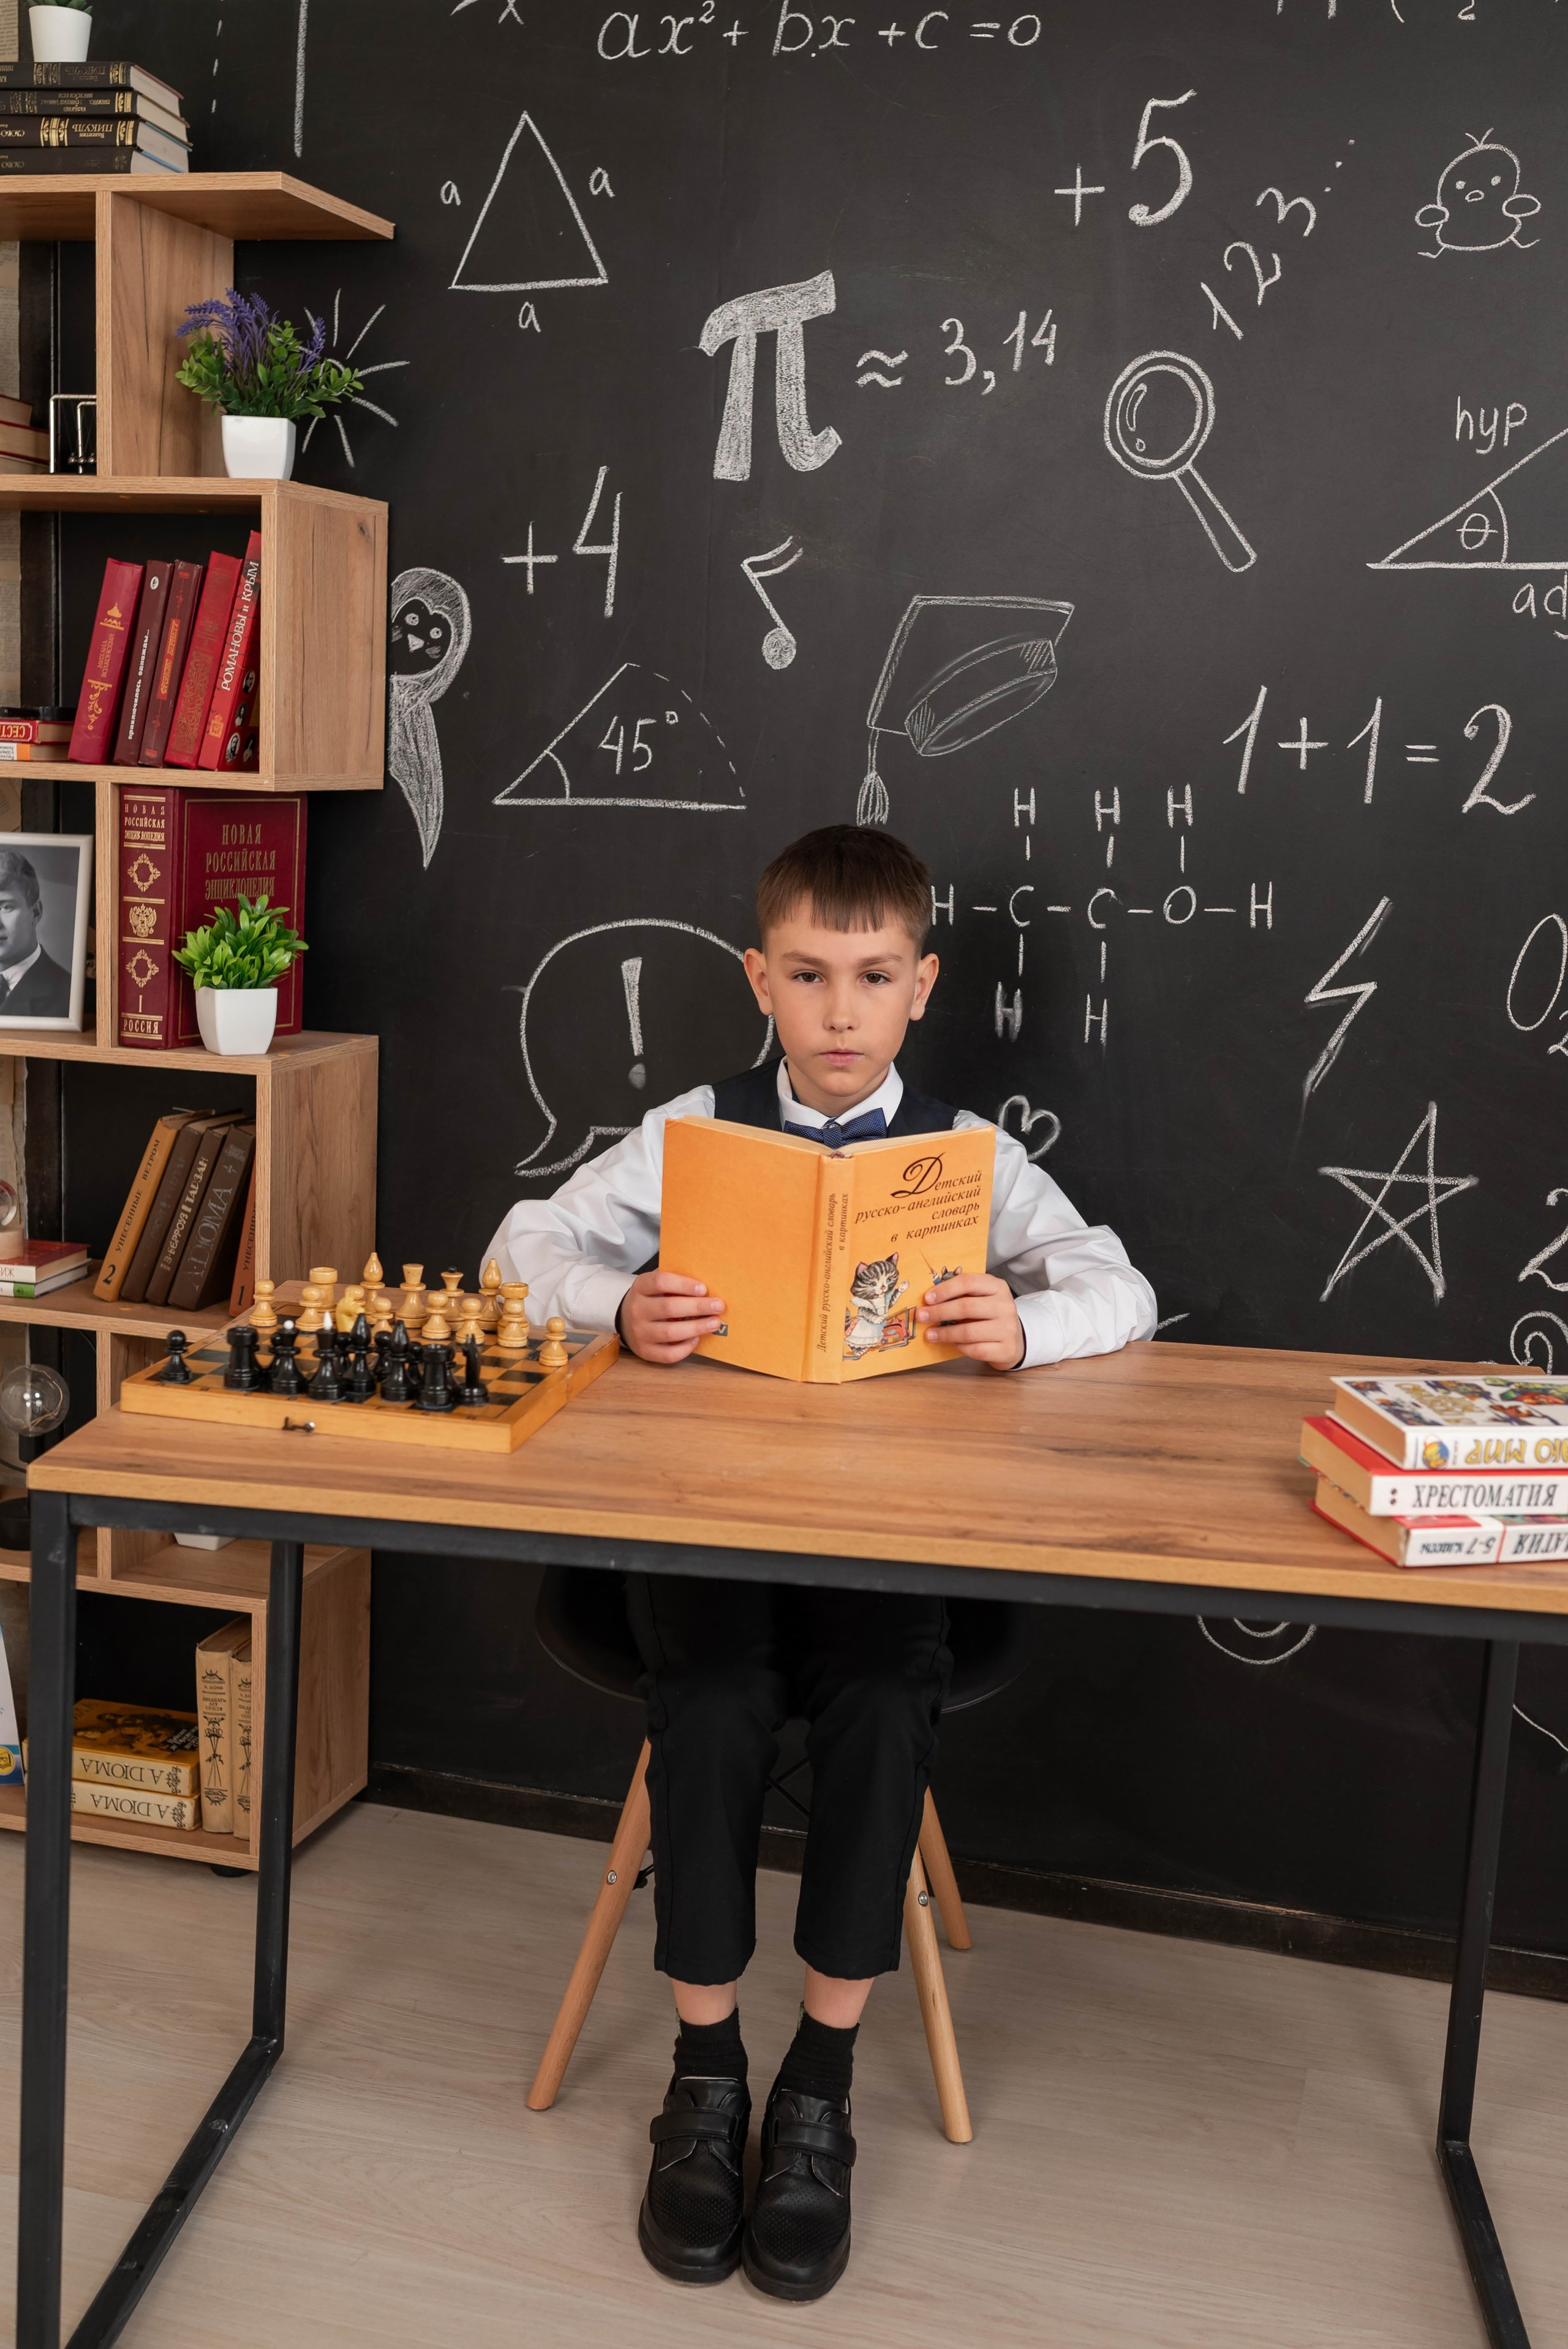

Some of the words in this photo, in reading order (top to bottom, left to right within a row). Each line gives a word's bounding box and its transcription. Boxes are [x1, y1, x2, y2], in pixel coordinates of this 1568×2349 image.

[72, 124, 114, 132] ПИКУЛЬ
[440, 181, 461, 205] a
[589, 167, 615, 197] a
[519, 301, 541, 333] a
[940, 309, 1057, 394] 3,14
[1456, 396, 1527, 454] hyp
[222, 614, 247, 691] РОМАНОВЫ
[241, 561, 260, 601] КРЫМ
[124, 804, 165, 815] НОВАЯ
[124, 816, 165, 829] РОССИЙСКАЯ
[124, 830, 165, 842] ЭНЦИКЛОПЕДИЯ
[222, 824, 262, 845] НОВАЯ
[205, 848, 276, 873] РОССИЙСКАЯ
[205, 877, 275, 903] ЭНЦИКЛОПЕДИЯ
[124, 1018, 159, 1034] РОССИЯ
[891, 1152, 981, 1199] Детский
[103, 1263, 116, 1285] 2
[115, 1190, 143, 1253] УНЕСЕННЫЕ
[141, 1139, 160, 1181] ВЕТРОМ
[827, 1193, 838, 1227] словарь
[855, 1185, 981, 1224] русско-английский
[932, 1202, 979, 1221] словарь
[840, 1193, 849, 1243] картинках
[906, 1215, 979, 1241] картинках
[823, 1229, 834, 1312] русско-английский
[817, 1313, 827, 1352] Детский
[1464, 1438, 1527, 1465] МИР
[1412, 1484, 1559, 1508] ХРЕСТОМАТИЯ
[1420, 1542, 1464, 1554] классы
[1465, 1536, 1496, 1555] 5-7
